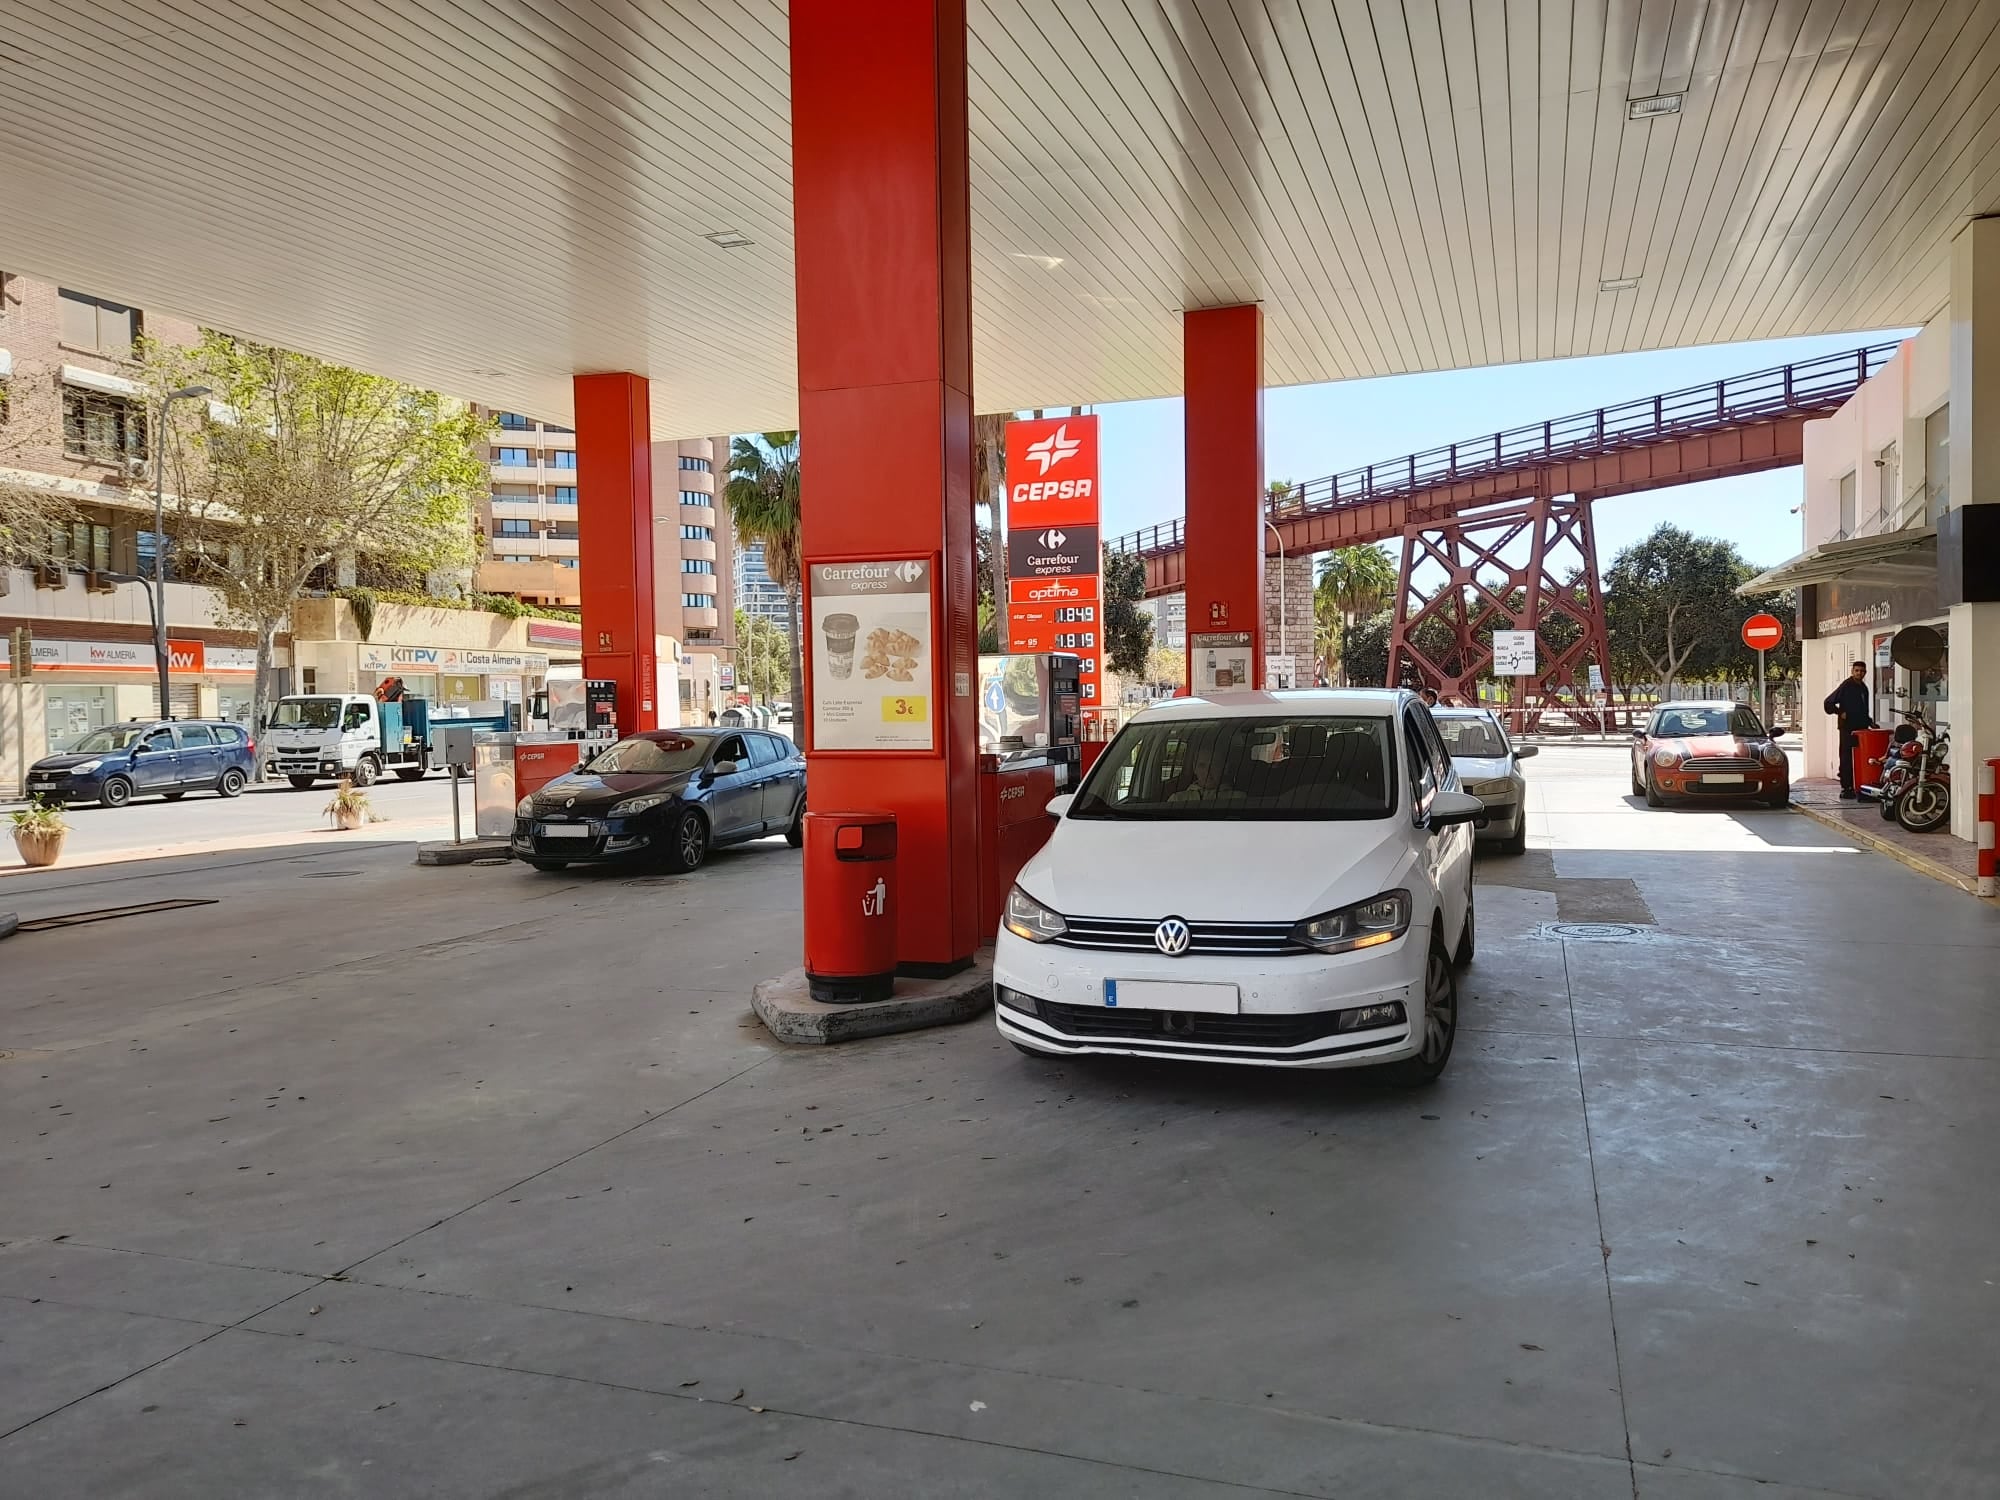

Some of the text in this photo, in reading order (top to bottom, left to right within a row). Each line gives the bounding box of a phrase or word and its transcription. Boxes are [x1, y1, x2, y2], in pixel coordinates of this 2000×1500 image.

[1013, 479, 1092, 503] CEPSA
[1027, 554, 1080, 566] Carrefour
[822, 565, 890, 580] Carrefour
[1035, 565, 1071, 576] express
[851, 581, 888, 592] express
[1029, 588, 1079, 600] optima
[1060, 607, 1094, 622] 1.849
[1028, 638, 1038, 646] 95
[1060, 633, 1094, 648] 1.819
[1197, 633, 1233, 641] Carrefour
[90, 646, 105, 658] kw
[168, 644, 195, 669] kw
[391, 648, 438, 663] KITPV
[466, 652, 490, 664] Costa
[364, 662, 388, 670] KITPV
[1007, 785, 1025, 798] CEPSA
